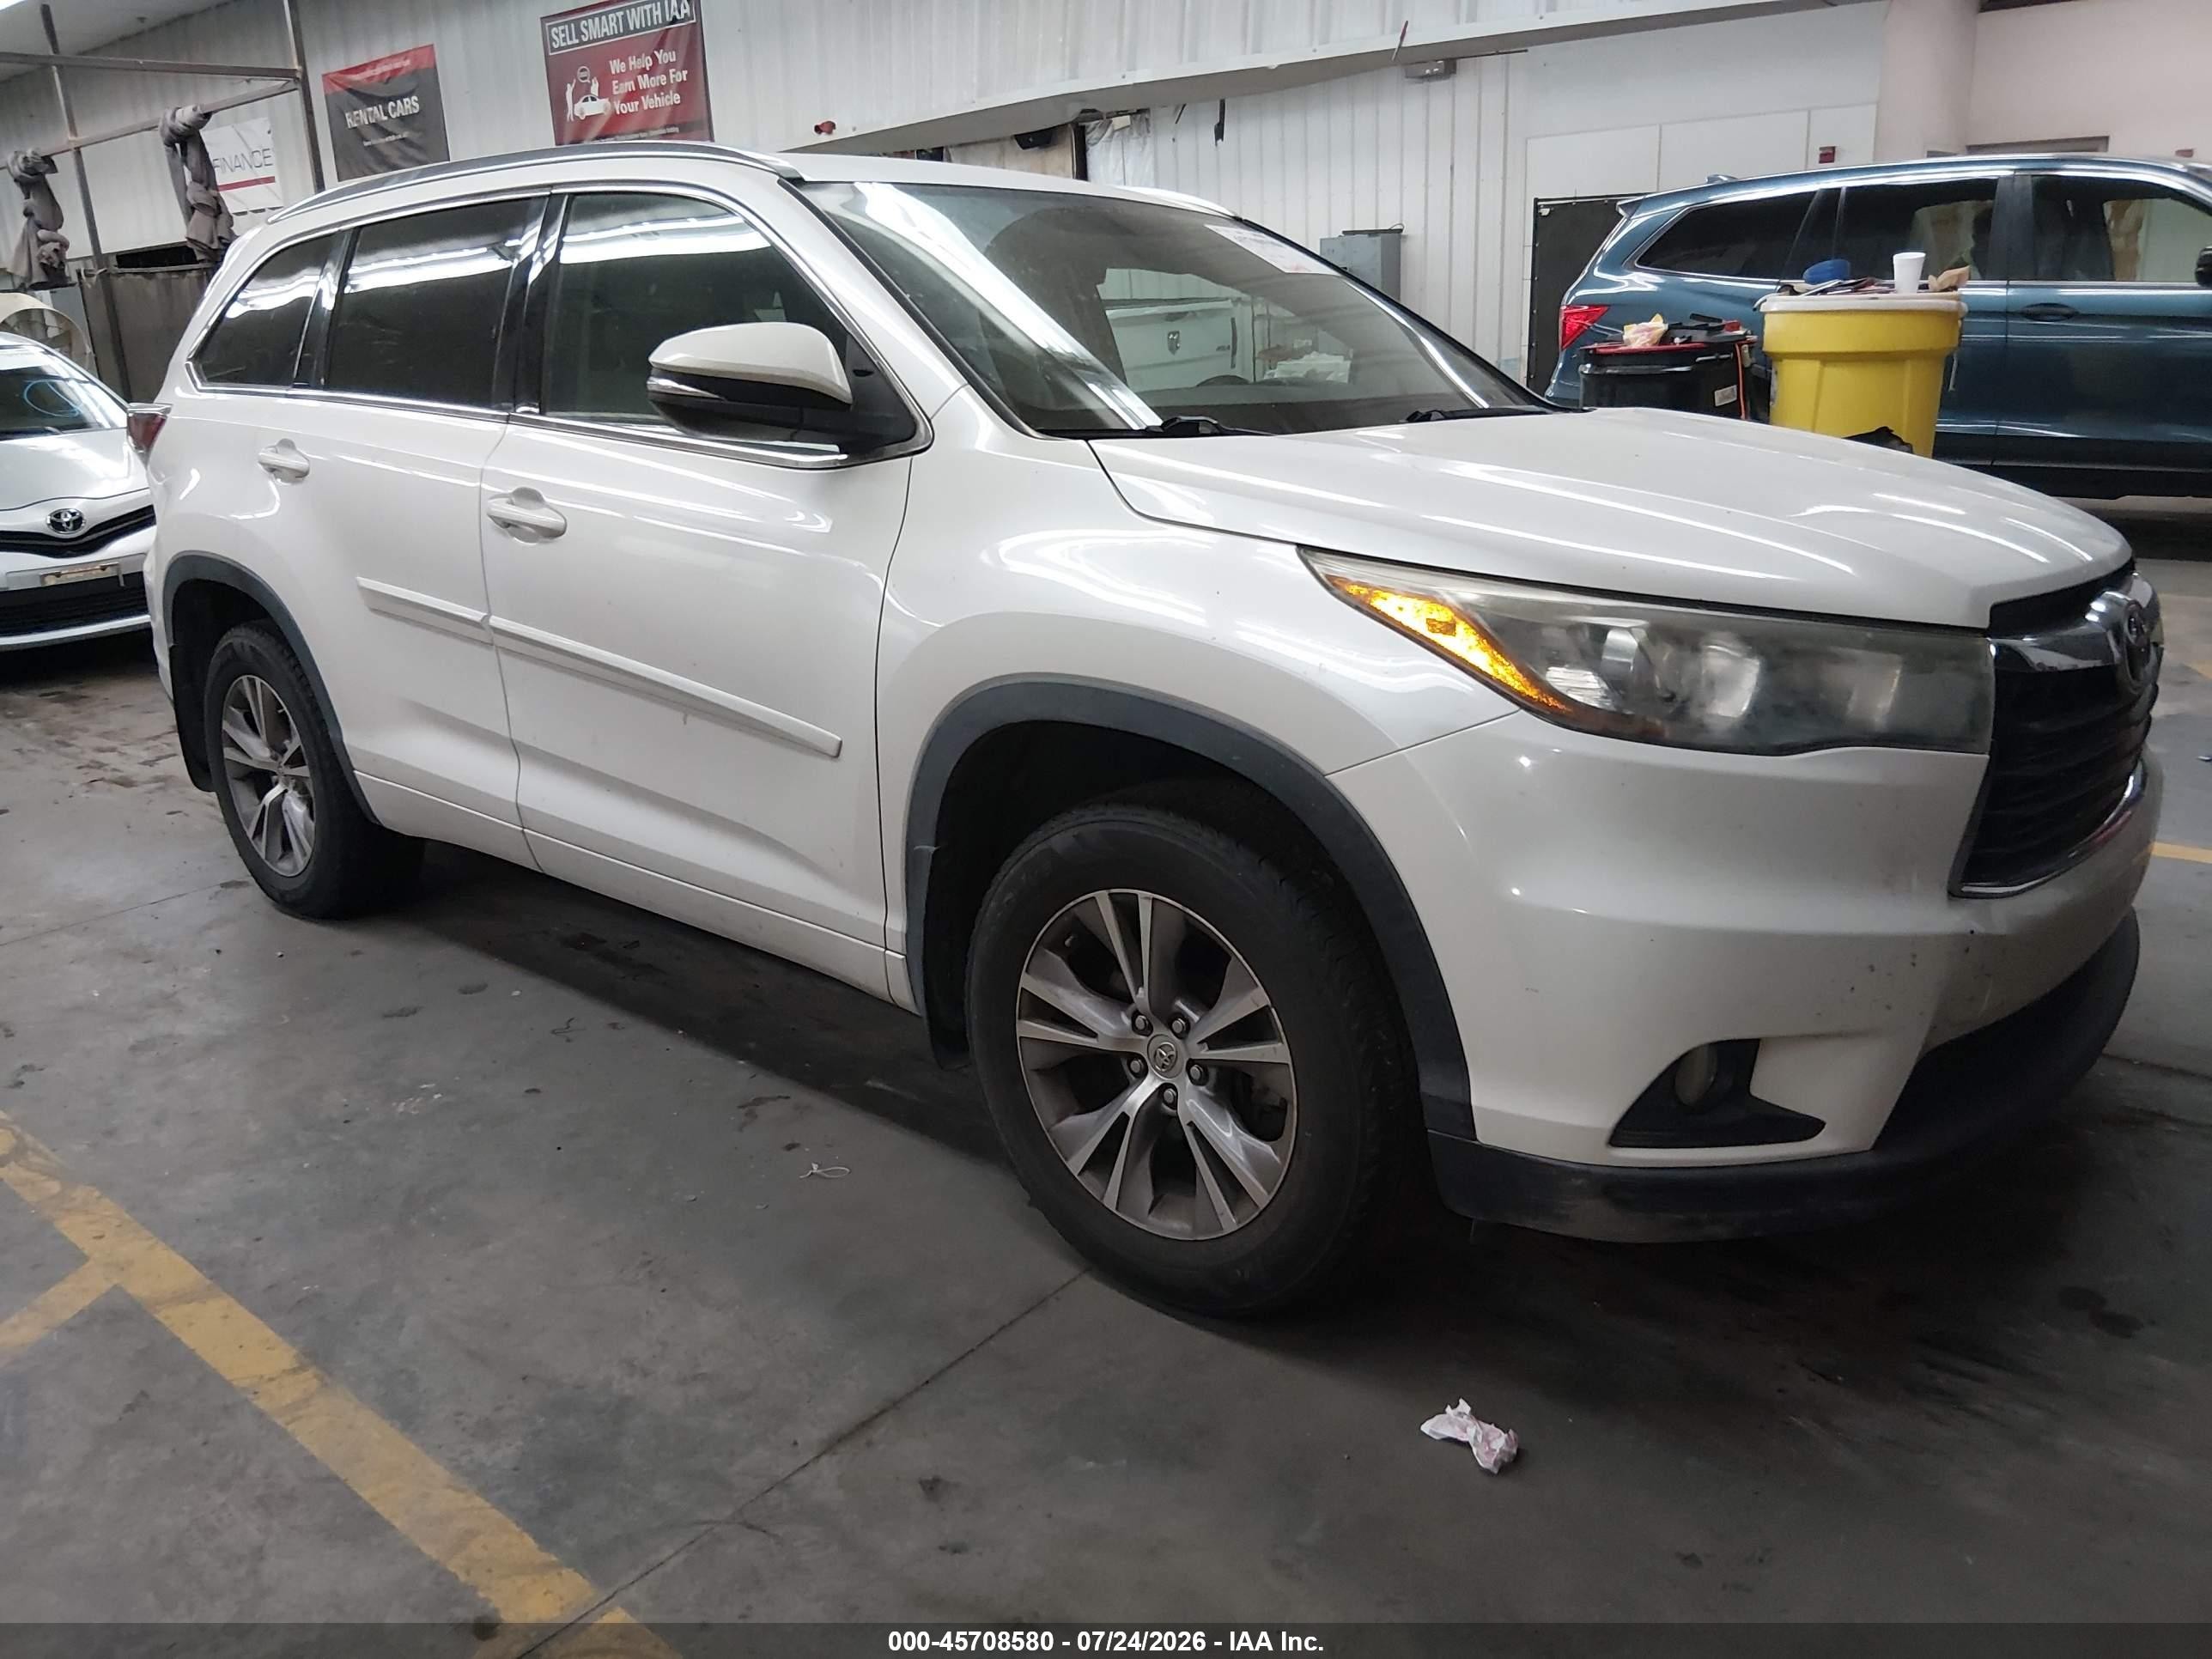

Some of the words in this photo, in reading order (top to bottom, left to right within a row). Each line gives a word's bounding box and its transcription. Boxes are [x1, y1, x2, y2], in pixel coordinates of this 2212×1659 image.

[550, 22, 579, 49] SELL
[580, 10, 624, 42] SMART
[626, 4, 663, 31] WITH
[664, 0, 691, 22] IAA
[610, 59, 626, 75] We
[629, 54, 653, 71] Help
[653, 49, 677, 64] You
[611, 80, 635, 95] Earn
[637, 73, 666, 90] More
[669, 69, 689, 83] For
[344, 104, 387, 129] RENTAL
[388, 95, 420, 118] CARS
[613, 100, 639, 115] Your
[641, 92, 681, 110] Vehicle
[212, 148, 274, 173] FINANCE
